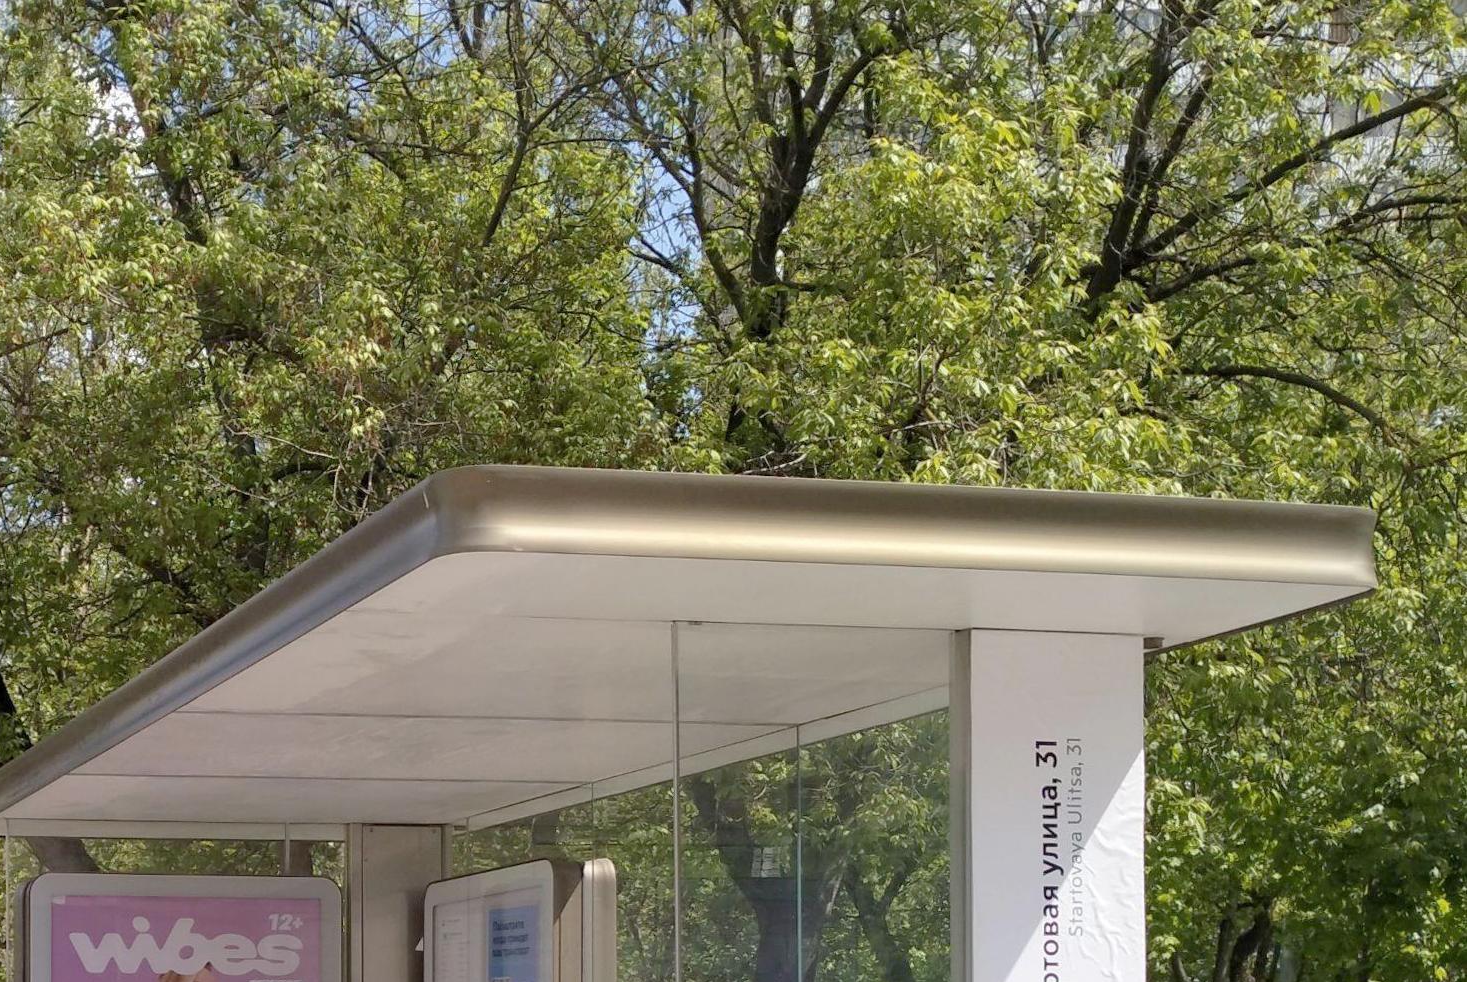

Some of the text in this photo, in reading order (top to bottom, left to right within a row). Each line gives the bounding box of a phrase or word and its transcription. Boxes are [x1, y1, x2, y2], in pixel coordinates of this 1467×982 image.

[1035, 740, 1058, 768] 31
[1042, 777, 1065, 876] улица,
[1066, 738, 1085, 937] Startovaya Ulitsa, 31
[69, 916, 304, 976] wibes
[268, 913, 304, 931] 12+
